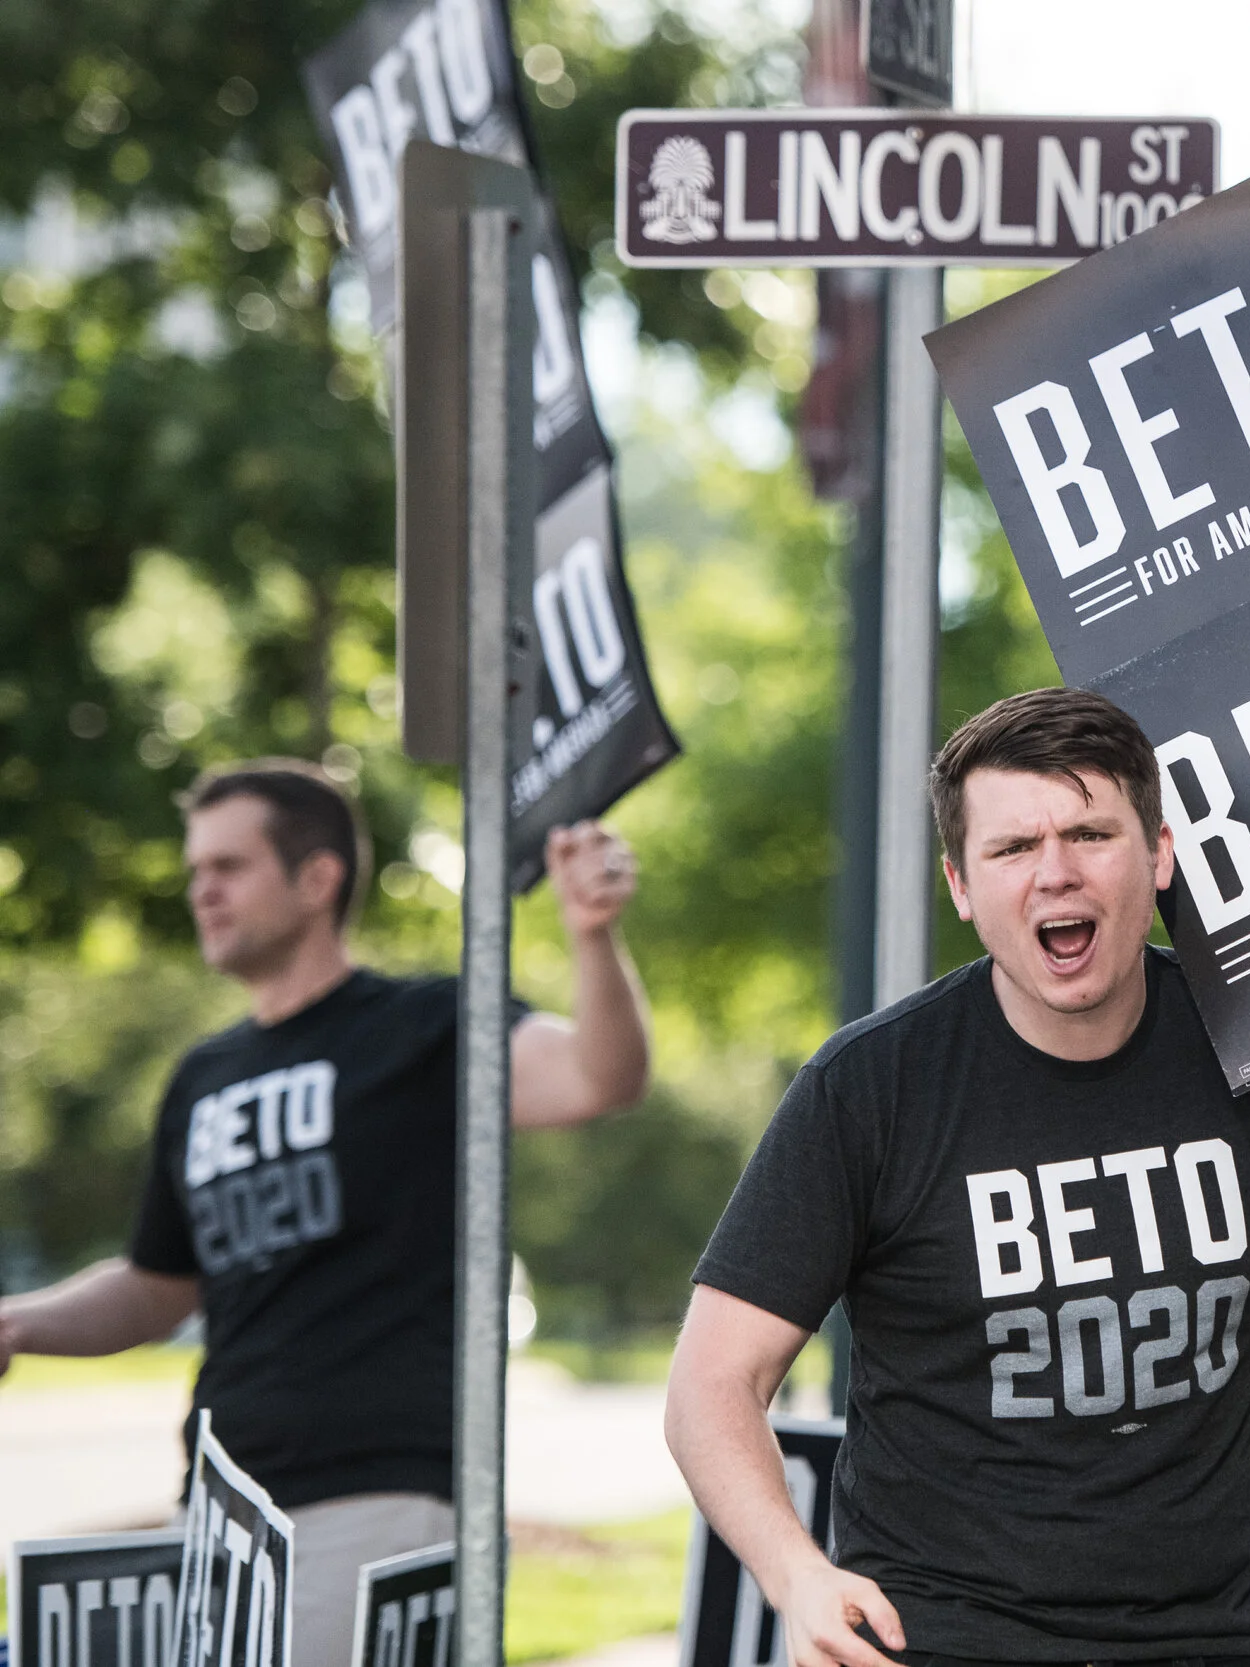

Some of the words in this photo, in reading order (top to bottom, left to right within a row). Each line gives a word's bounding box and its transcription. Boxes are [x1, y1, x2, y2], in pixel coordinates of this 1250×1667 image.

[724, 130, 1101, 248] LINCOLN
[1128, 125, 1190, 185] ST
[1101, 191, 1205, 250] 100
[1133, 535, 1200, 597] FOR
[185, 1058, 337, 1189] BETO
[189, 1150, 342, 1277] 2020
[966, 1138, 1248, 1299] BETO
[985, 1275, 1250, 1418] 2020
